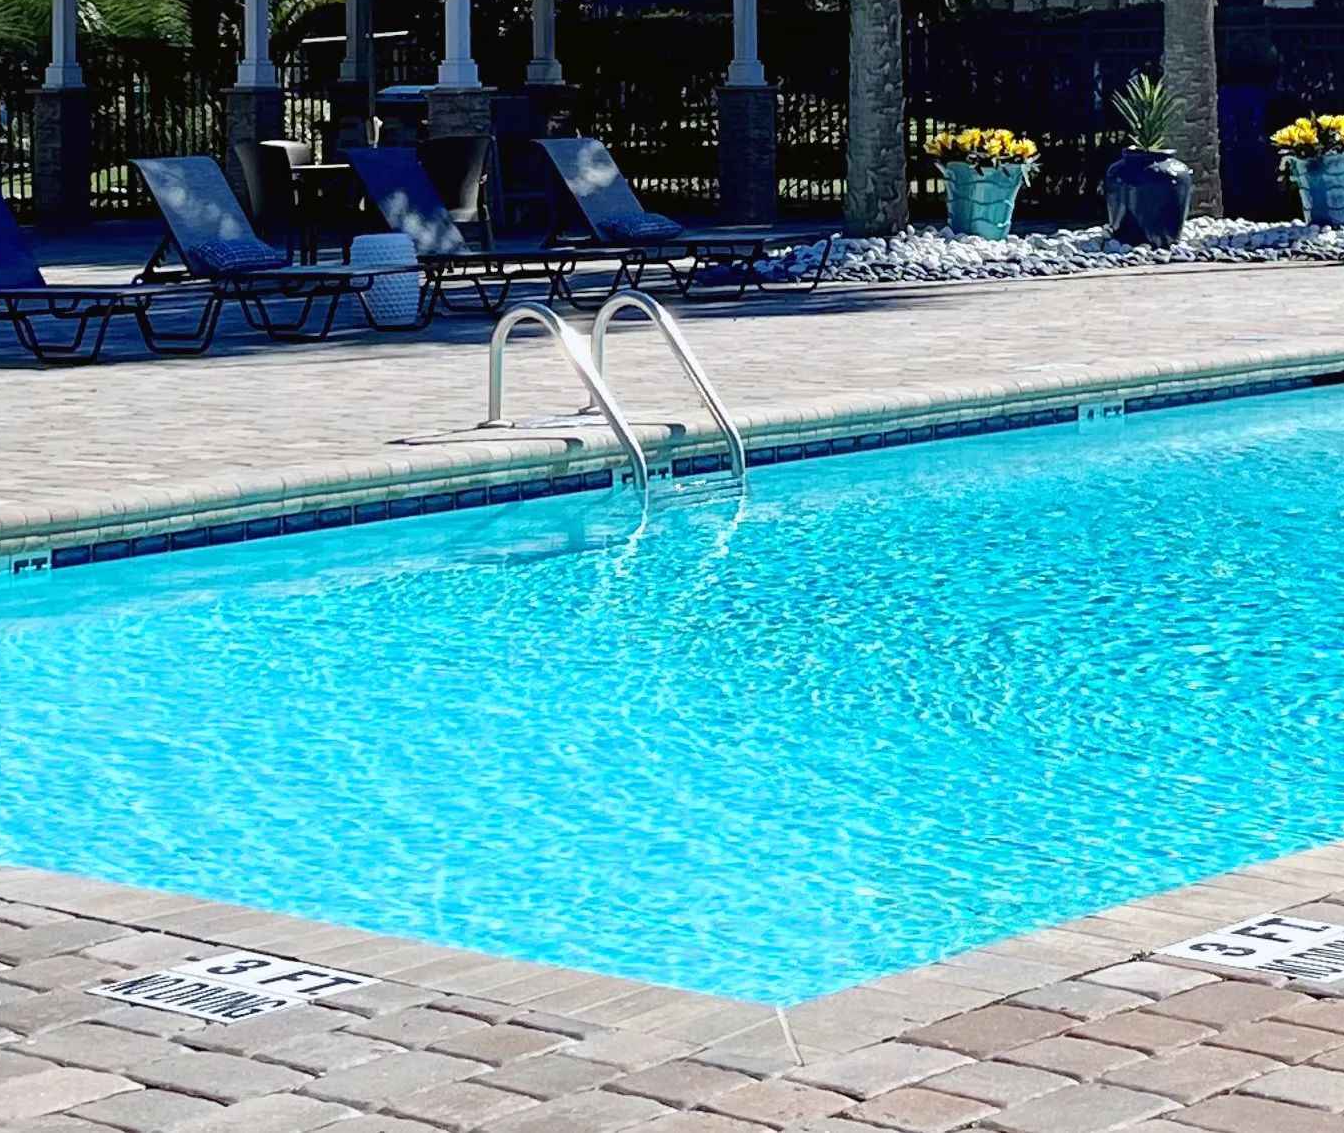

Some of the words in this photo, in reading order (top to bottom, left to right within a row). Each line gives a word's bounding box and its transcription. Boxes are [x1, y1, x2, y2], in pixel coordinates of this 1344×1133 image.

[1188, 942, 1257, 957] 3
[206, 959, 272, 975] 3
[1256, 960, 1344, 980] NO
[101, 973, 186, 997] NO
[144, 981, 289, 1019] DIVING
